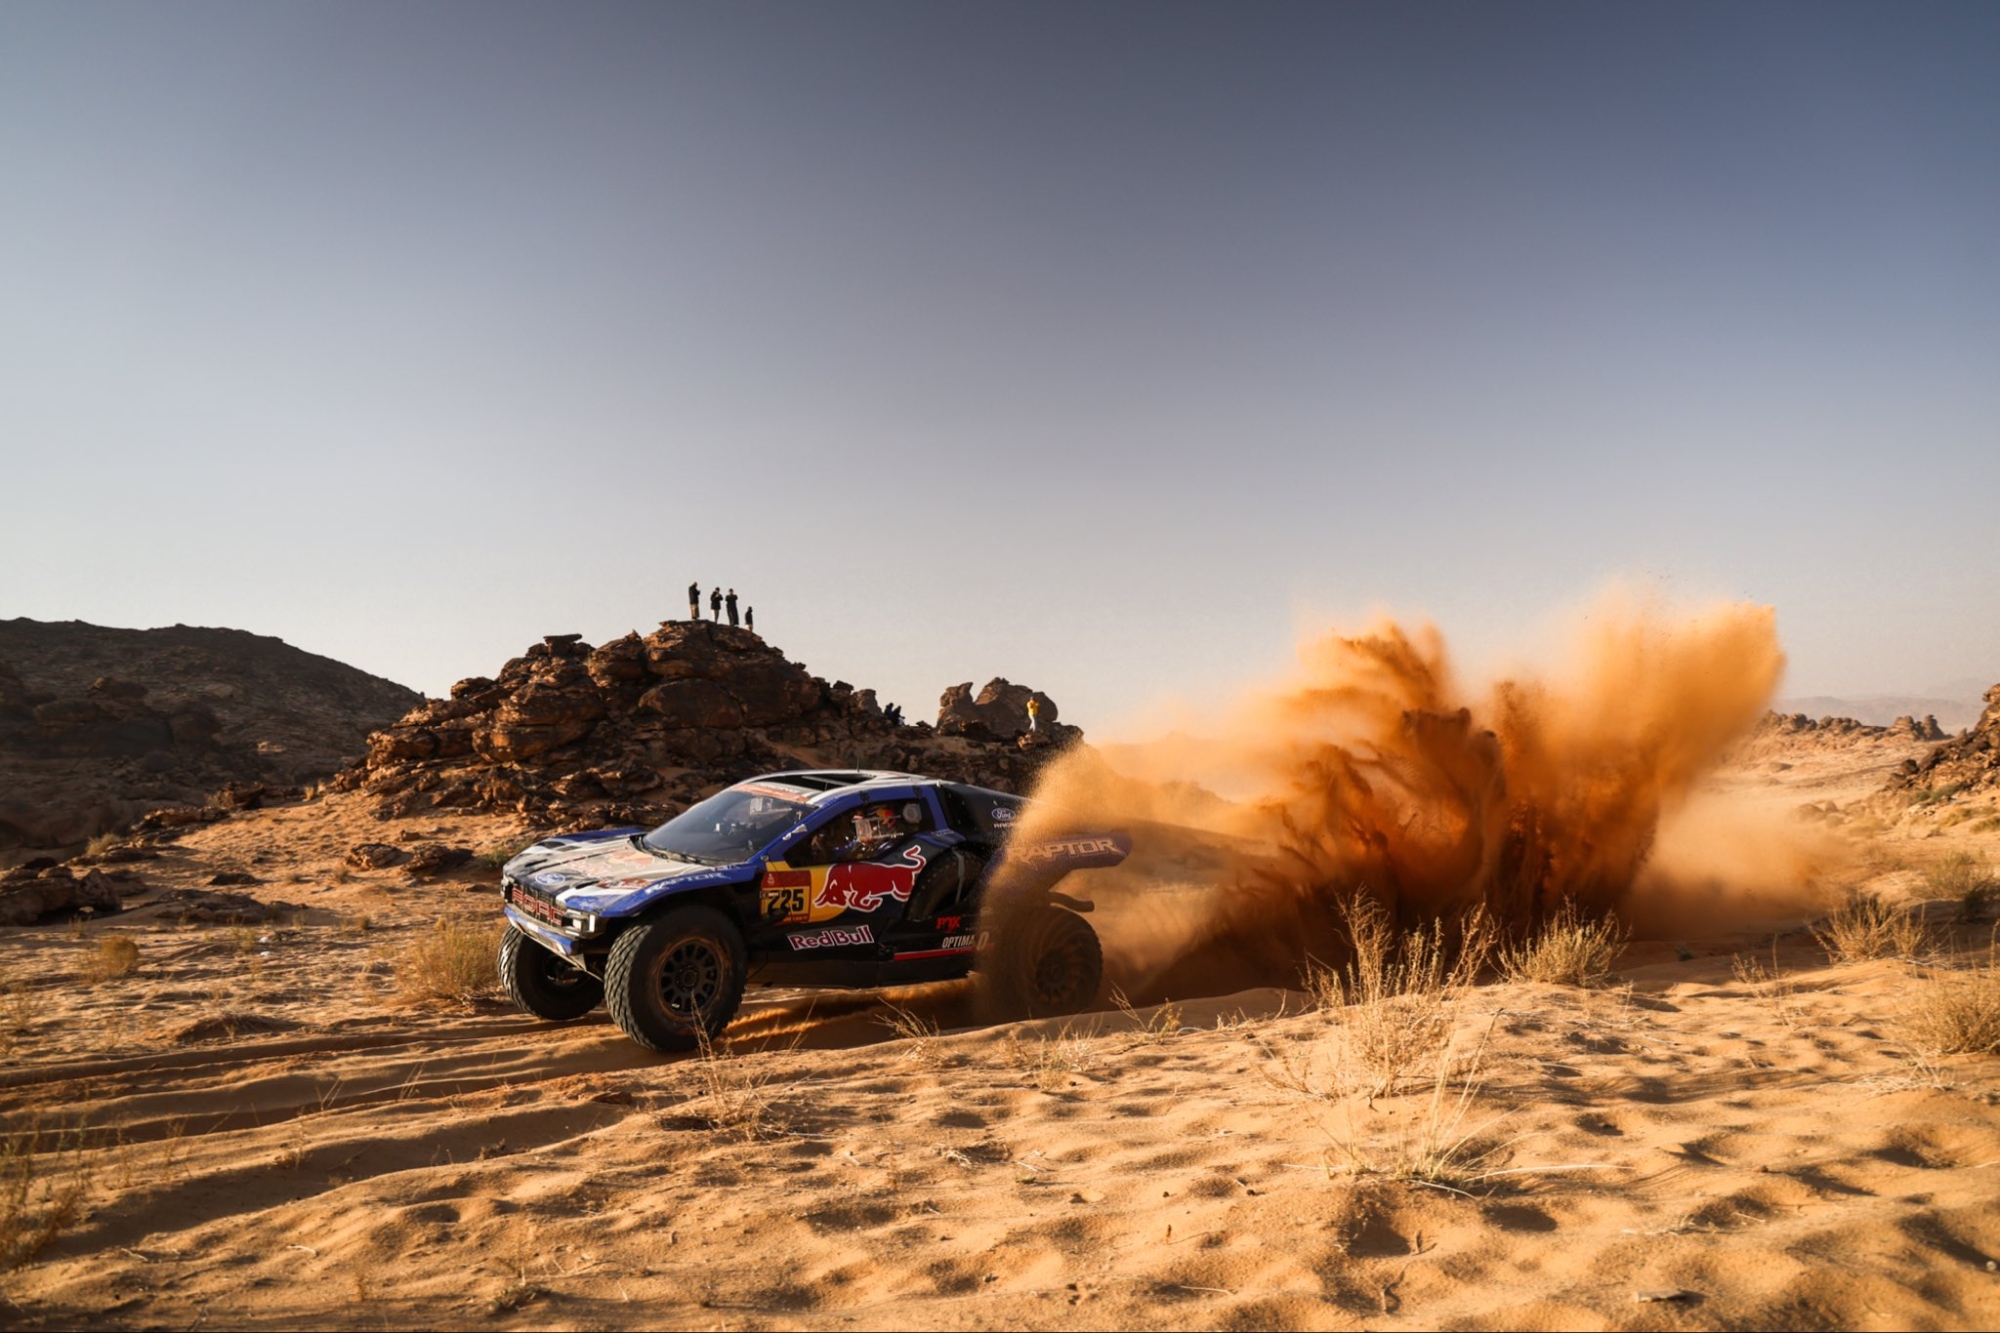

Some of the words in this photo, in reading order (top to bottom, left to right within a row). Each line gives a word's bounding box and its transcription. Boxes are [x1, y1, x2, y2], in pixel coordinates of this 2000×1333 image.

[1004, 837, 1127, 871] RAPTOR
[644, 872, 732, 895] RAPTOR
[787, 930, 835, 951] Red
[830, 924, 875, 947] Bull
[941, 934, 976, 949] OPTIMA
